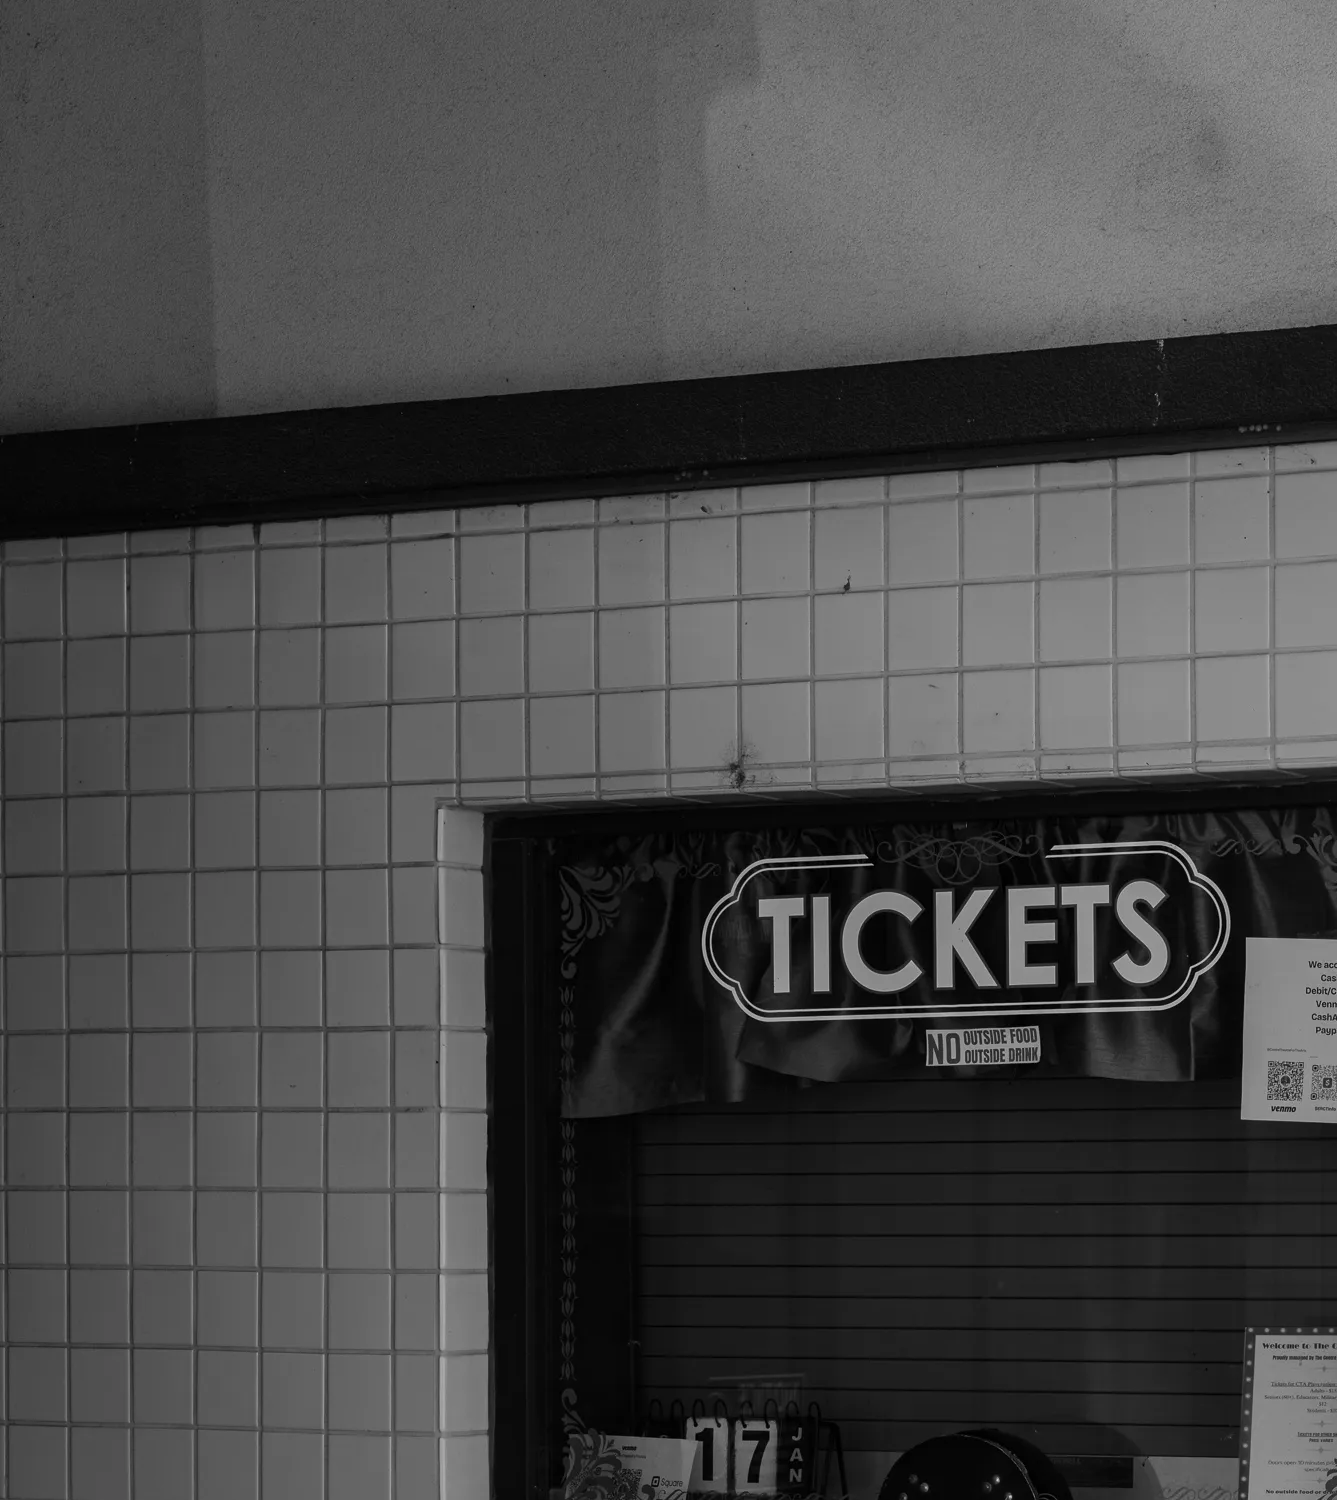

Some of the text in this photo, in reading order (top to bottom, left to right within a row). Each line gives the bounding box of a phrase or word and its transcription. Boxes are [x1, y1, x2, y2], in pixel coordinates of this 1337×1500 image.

[756, 878, 1171, 995] TICKETS
[1308, 960, 1323, 969] We
[963, 1028, 1038, 1046] OUTSIDE FOOD
[928, 1032, 961, 1066] NO
[964, 1046, 1039, 1064] OUTSIDE DRINK
[1270, 1104, 1297, 1113] venmo
[1262, 1342, 1300, 1350] Welcome
[1302, 1342, 1311, 1350] to
[1313, 1342, 1330, 1350] The
[789, 1427, 803, 1483] JAN
[660, 1478, 684, 1488] Square
